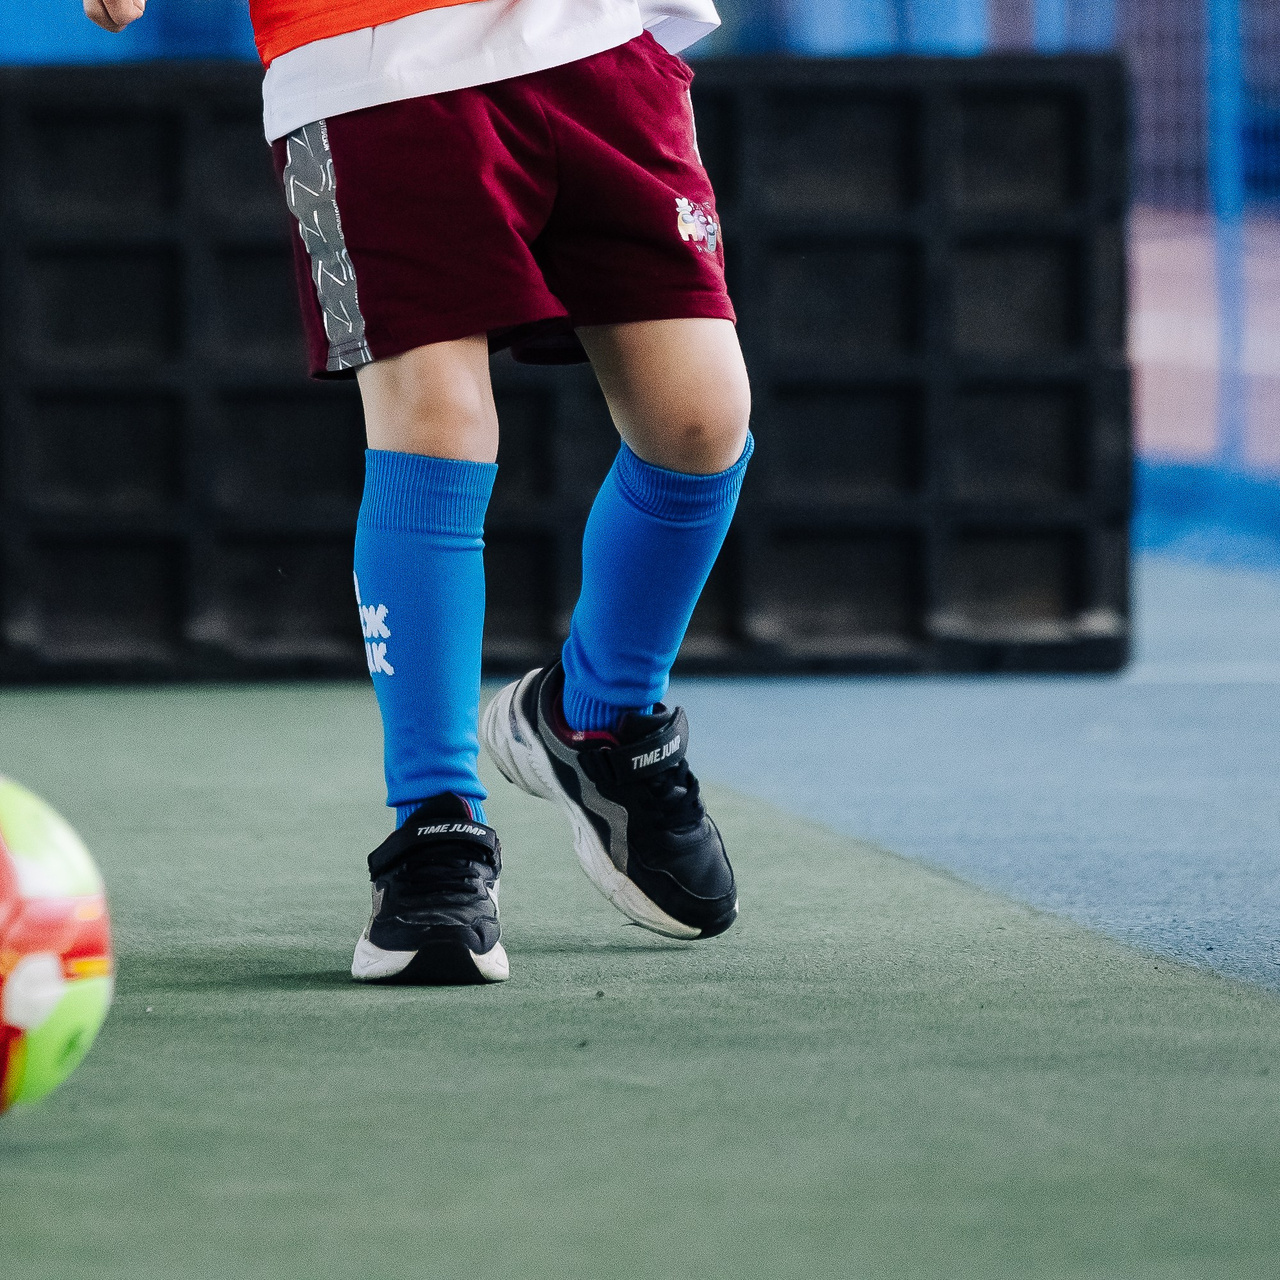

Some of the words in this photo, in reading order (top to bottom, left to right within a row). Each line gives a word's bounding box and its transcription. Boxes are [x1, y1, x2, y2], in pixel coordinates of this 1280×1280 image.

[631, 748, 661, 770] TIME
[417, 823, 451, 836] TIME
[449, 823, 487, 836] JUMP
